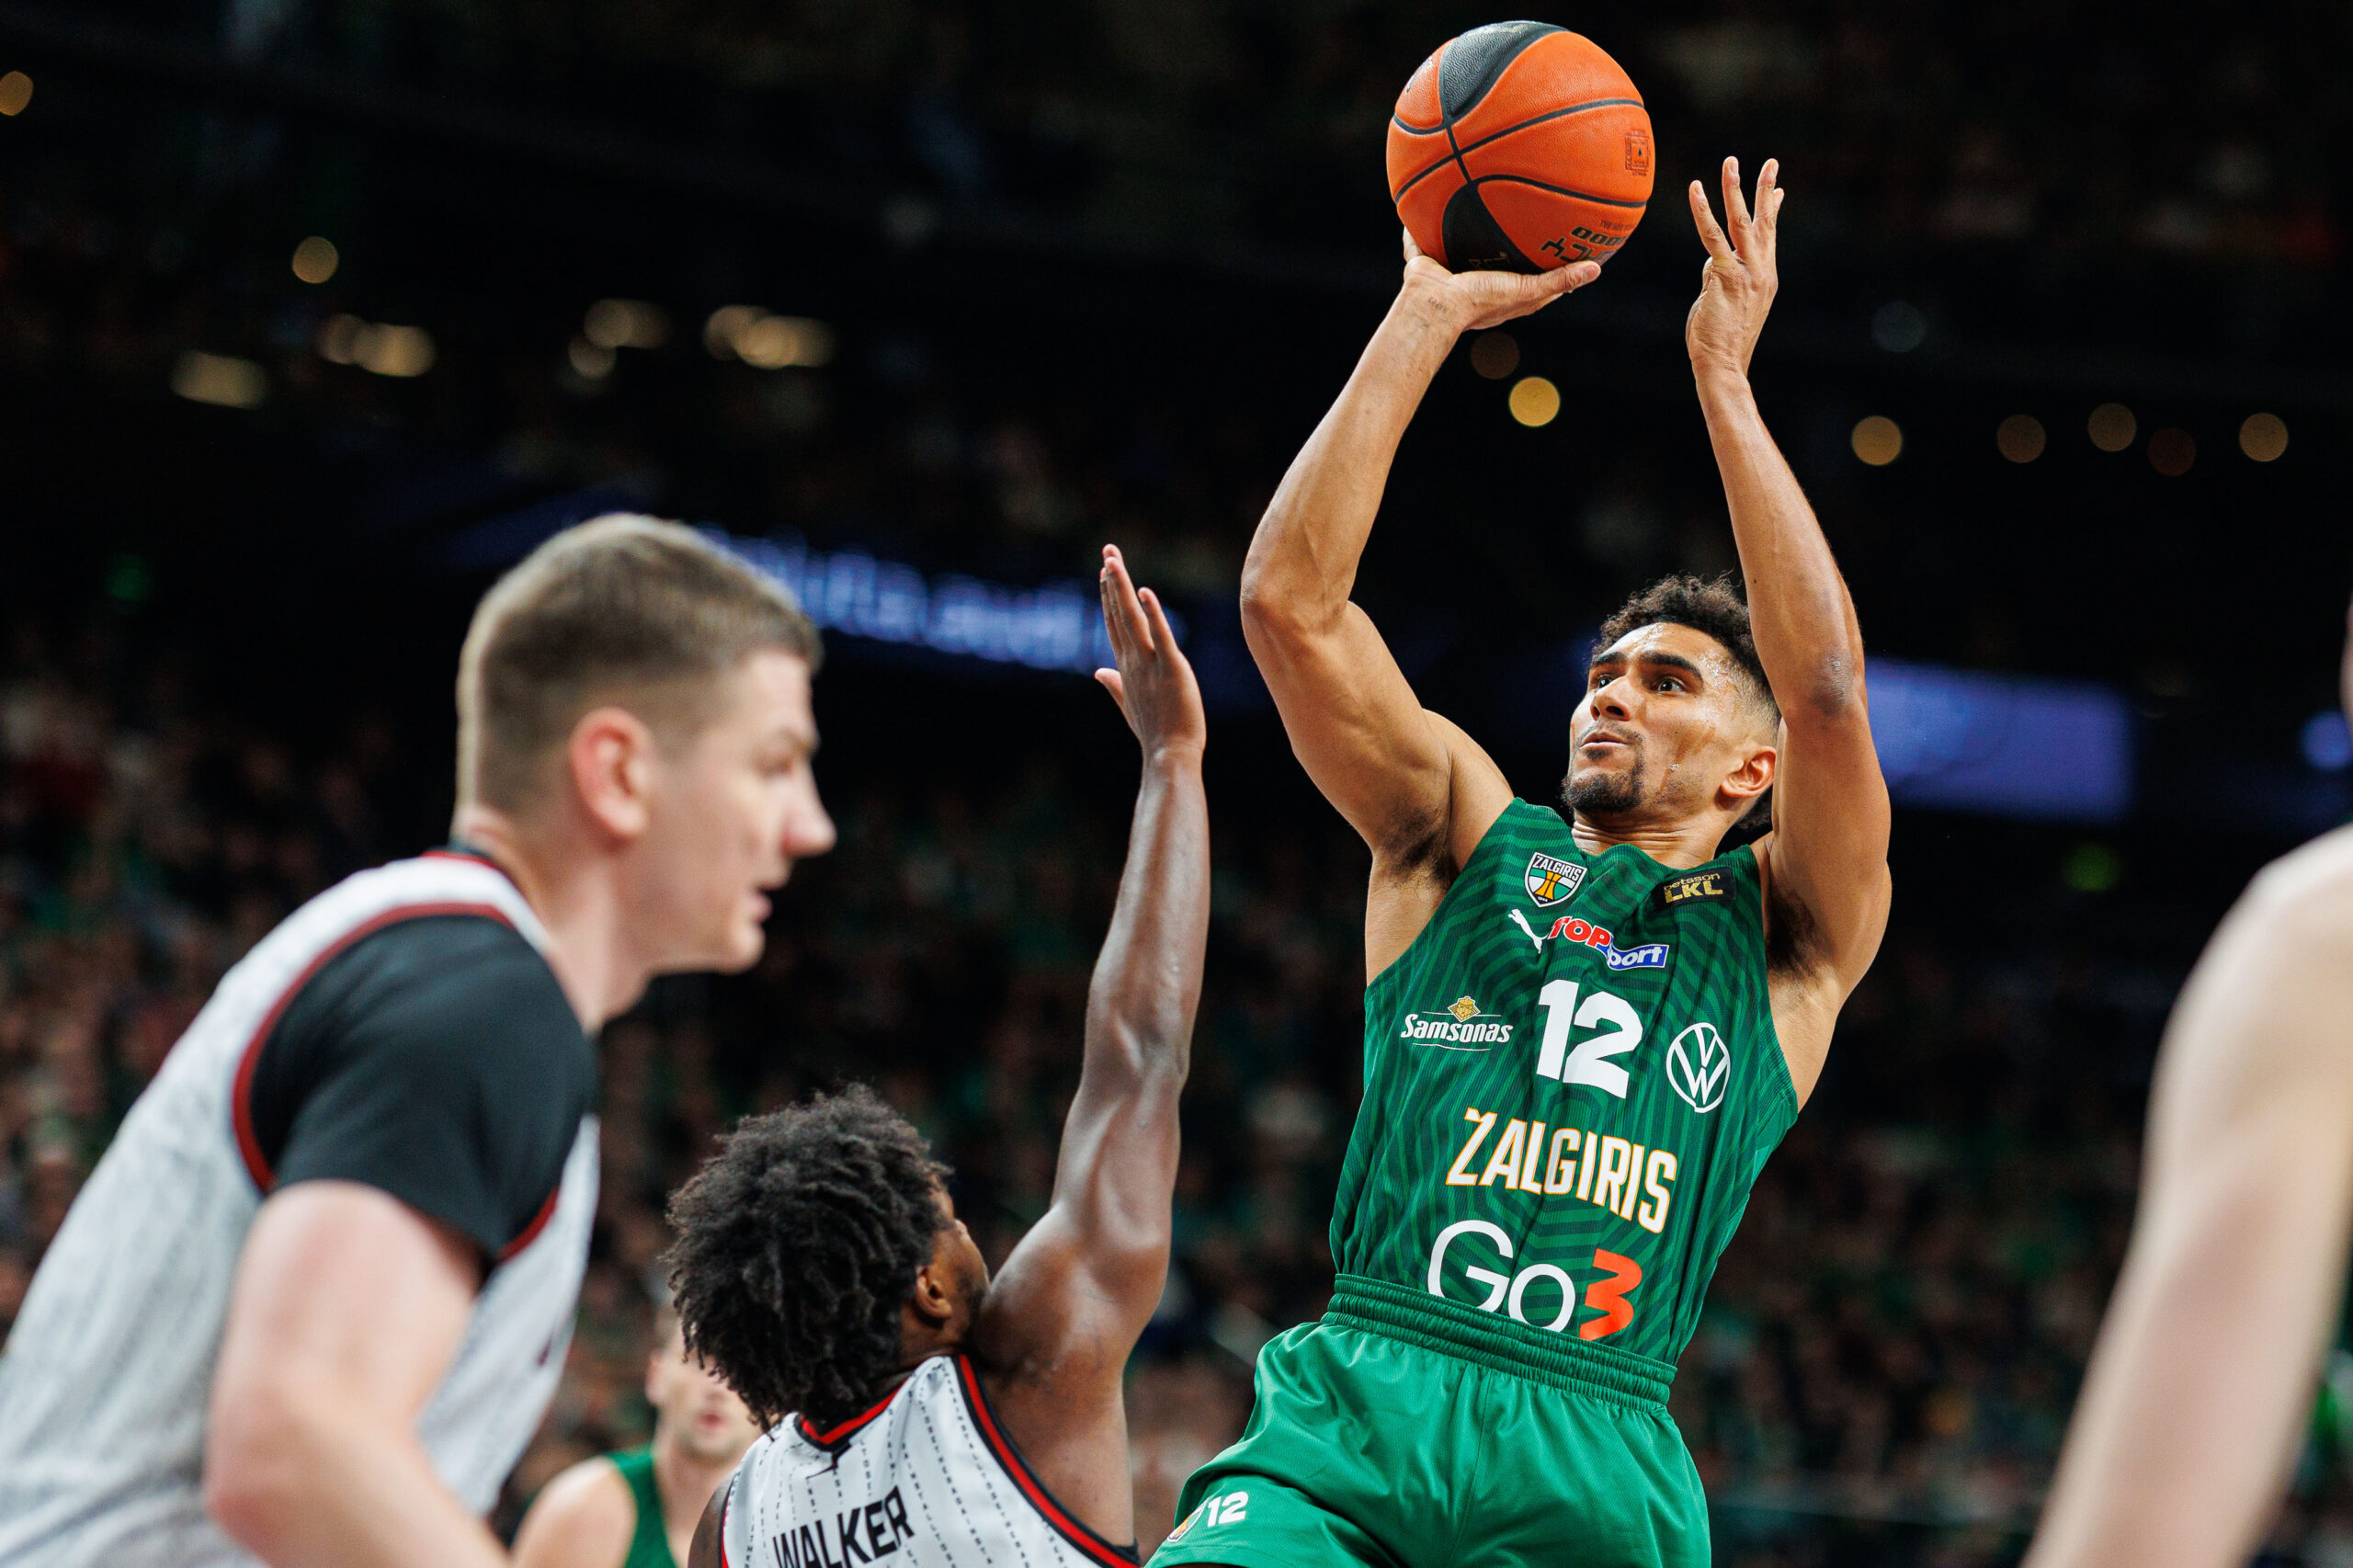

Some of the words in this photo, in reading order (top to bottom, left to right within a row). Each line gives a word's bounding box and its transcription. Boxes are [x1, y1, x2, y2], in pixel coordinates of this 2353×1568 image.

[1664, 872, 1721, 892] betsson
[1665, 880, 1723, 903] LKL
[1401, 1014, 1514, 1043] Samsonas
[1537, 979, 1643, 1099] 12
[773, 1484, 915, 1568] WALKER
[1207, 1491, 1249, 1528] 12
